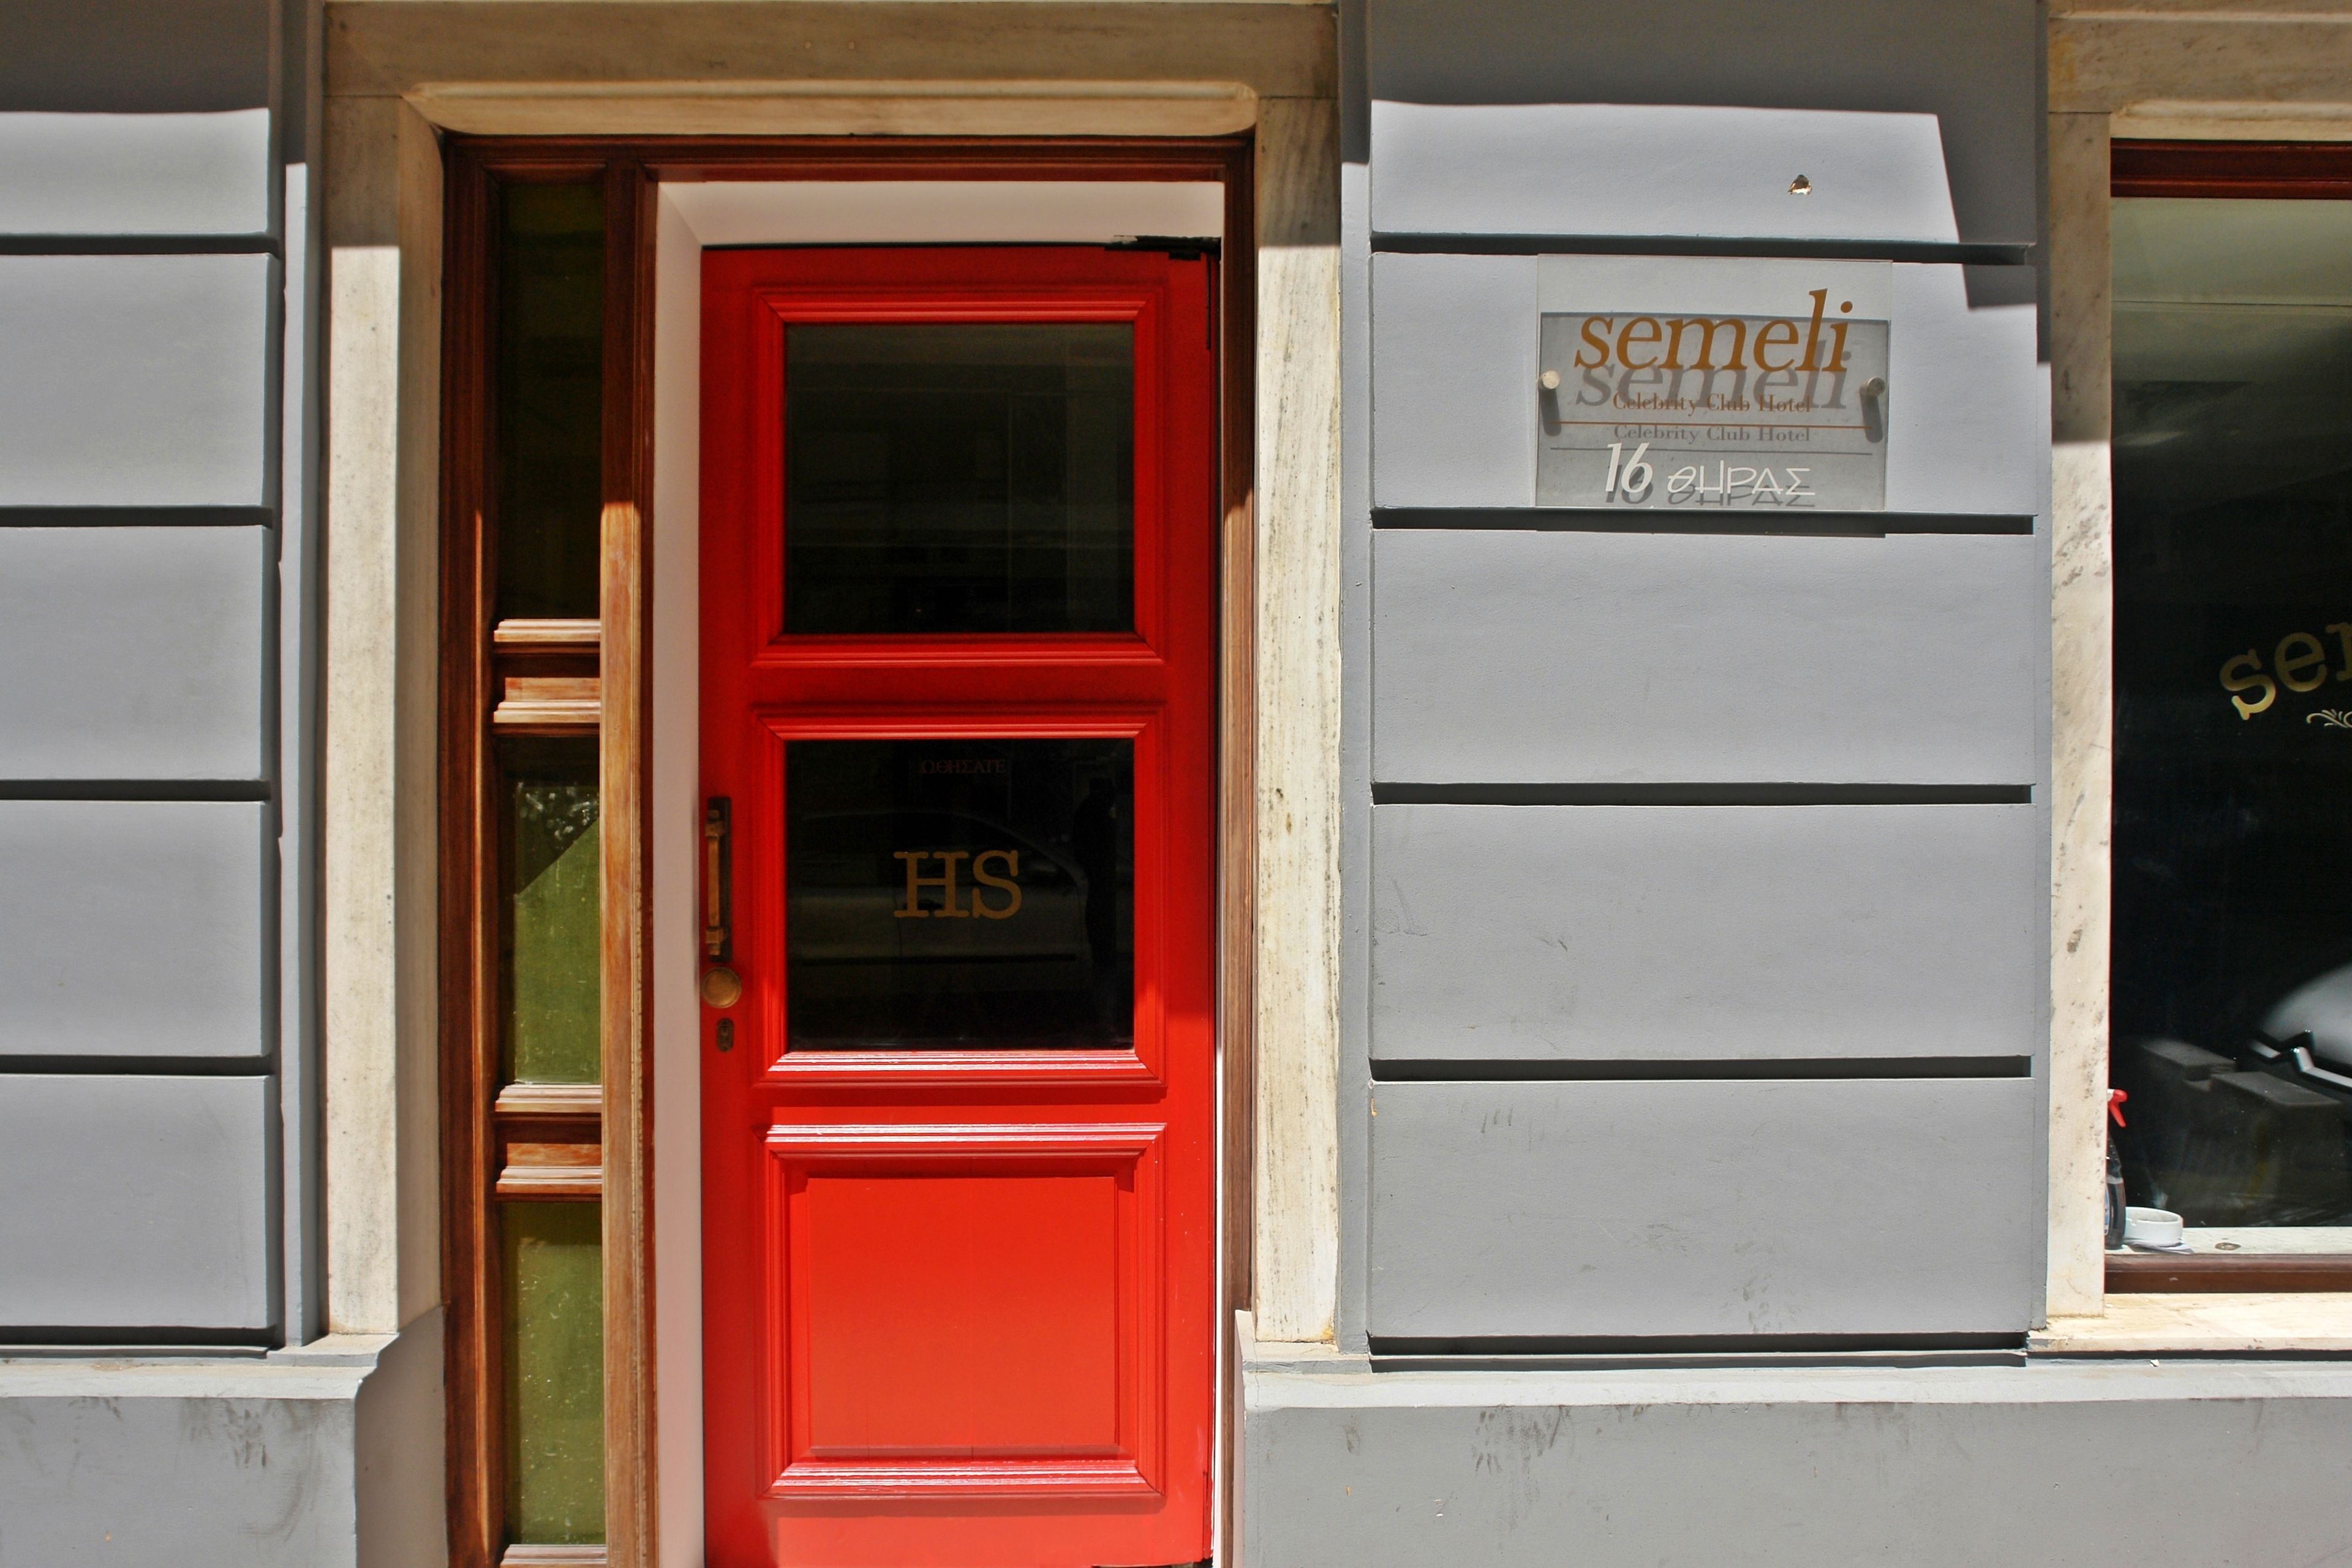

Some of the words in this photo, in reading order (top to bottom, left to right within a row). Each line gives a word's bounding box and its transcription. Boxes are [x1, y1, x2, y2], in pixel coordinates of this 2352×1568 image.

[1574, 287, 1853, 373] semeli
[1612, 392, 1697, 417] Celebrity
[1706, 393, 1751, 412] Club
[1757, 393, 1811, 413] Hotel
[1605, 441, 1654, 494] 16
[2218, 622, 2352, 721] se
[892, 849, 1022, 919] HS
